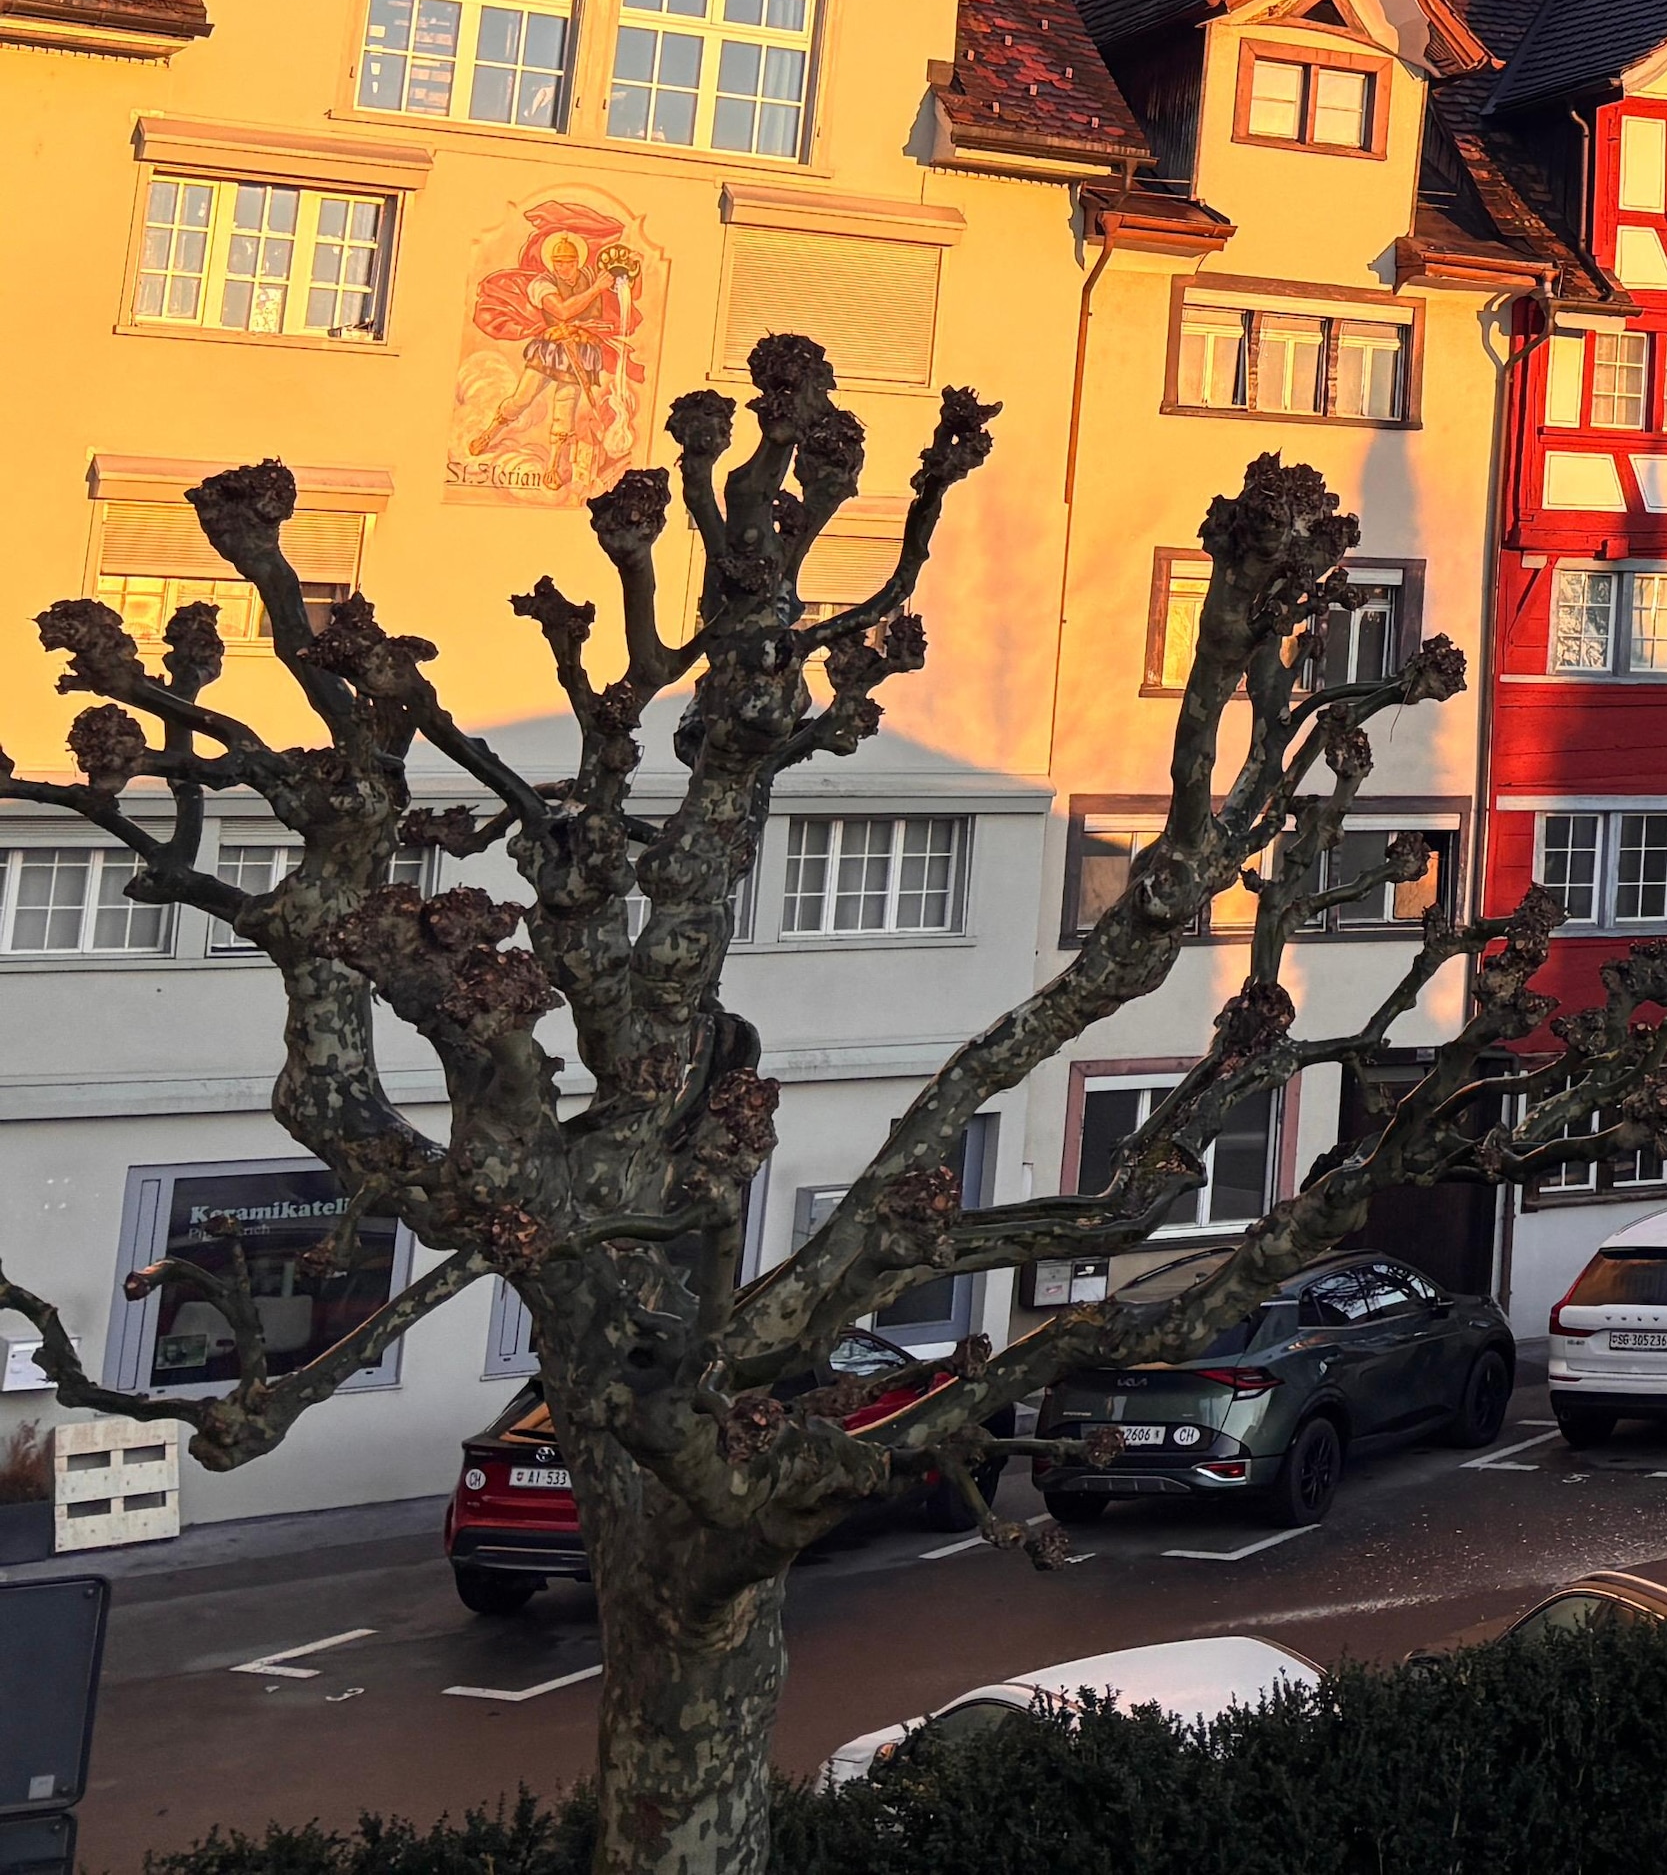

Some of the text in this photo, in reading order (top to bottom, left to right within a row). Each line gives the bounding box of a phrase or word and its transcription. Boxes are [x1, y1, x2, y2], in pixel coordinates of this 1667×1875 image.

[444, 461, 541, 487] St. Florian
[1117, 1377, 1148, 1387] KIA
[1179, 1428, 1195, 1442] CH
[469, 1472, 481, 1486] CH
